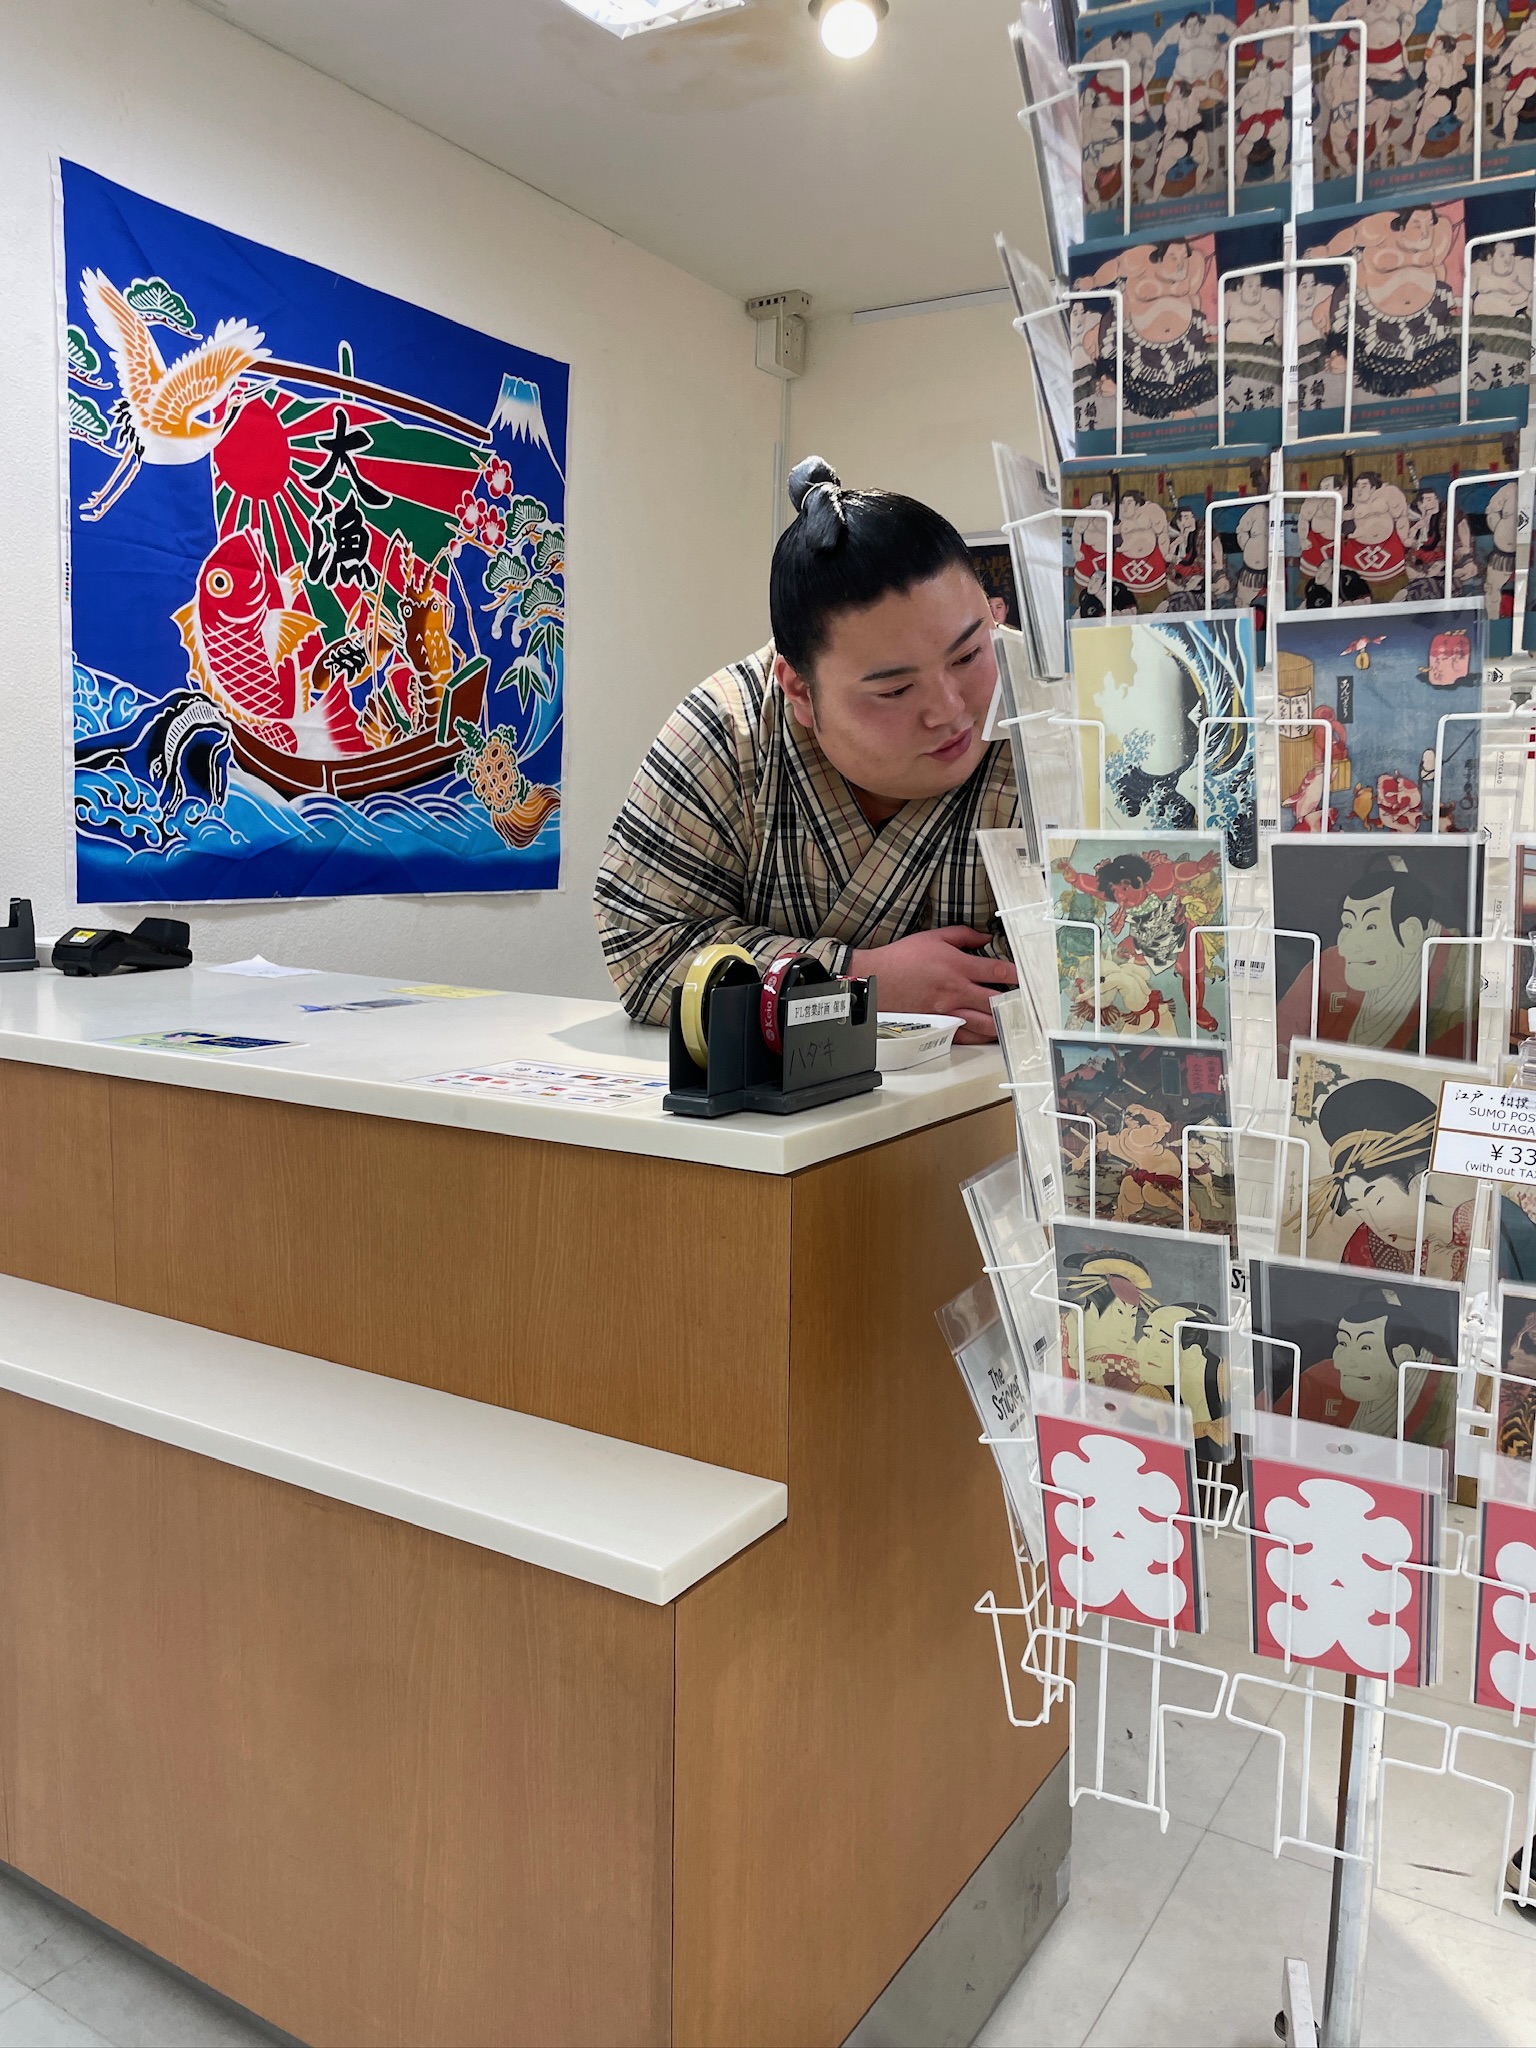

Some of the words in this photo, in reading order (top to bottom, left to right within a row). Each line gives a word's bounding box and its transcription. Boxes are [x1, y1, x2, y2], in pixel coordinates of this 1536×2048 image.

[301, 408, 393, 589] 大漁
[764, 1000, 773, 1028] Keio
[1468, 1106, 1506, 1120] SUMO
[1510, 1111, 1536, 1123] POS
[1491, 1122, 1535, 1136] UTAGA
[1465, 1160, 1493, 1172] (with
[1496, 1167, 1515, 1176] out
[987, 1366, 1005, 1391] The
